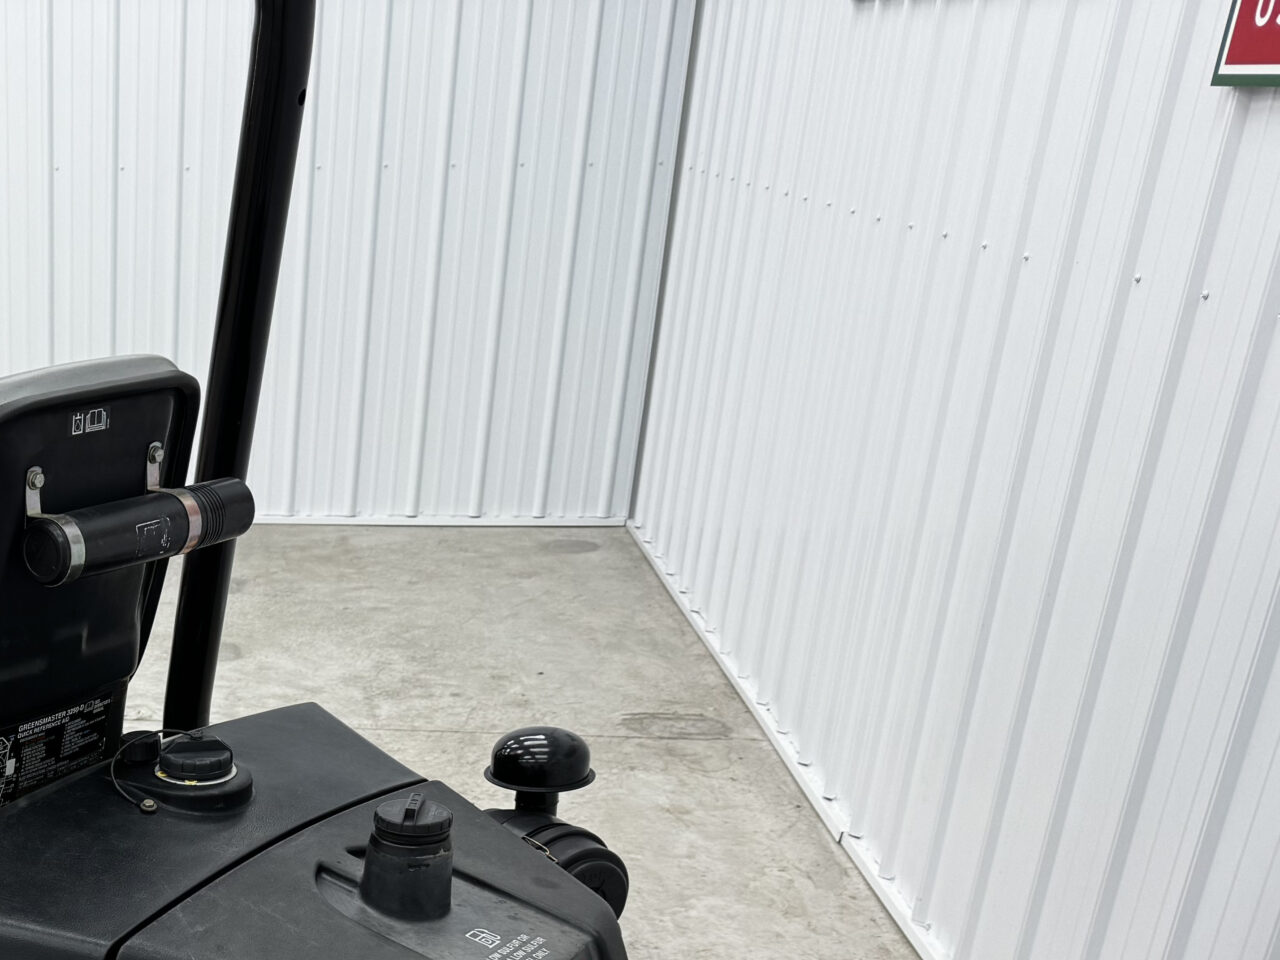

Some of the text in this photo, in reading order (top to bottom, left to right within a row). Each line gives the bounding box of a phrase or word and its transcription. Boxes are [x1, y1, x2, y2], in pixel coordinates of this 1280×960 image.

[18, 710, 67, 732] GREENSMASTER
[33, 719, 61, 735] REFERENCE
[497, 939, 522, 955] SULFUR
[517, 933, 530, 942] OR
[509, 949, 527, 960] LOW
[521, 936, 547, 952] SULFUR
[532, 947, 550, 960] ONLY
